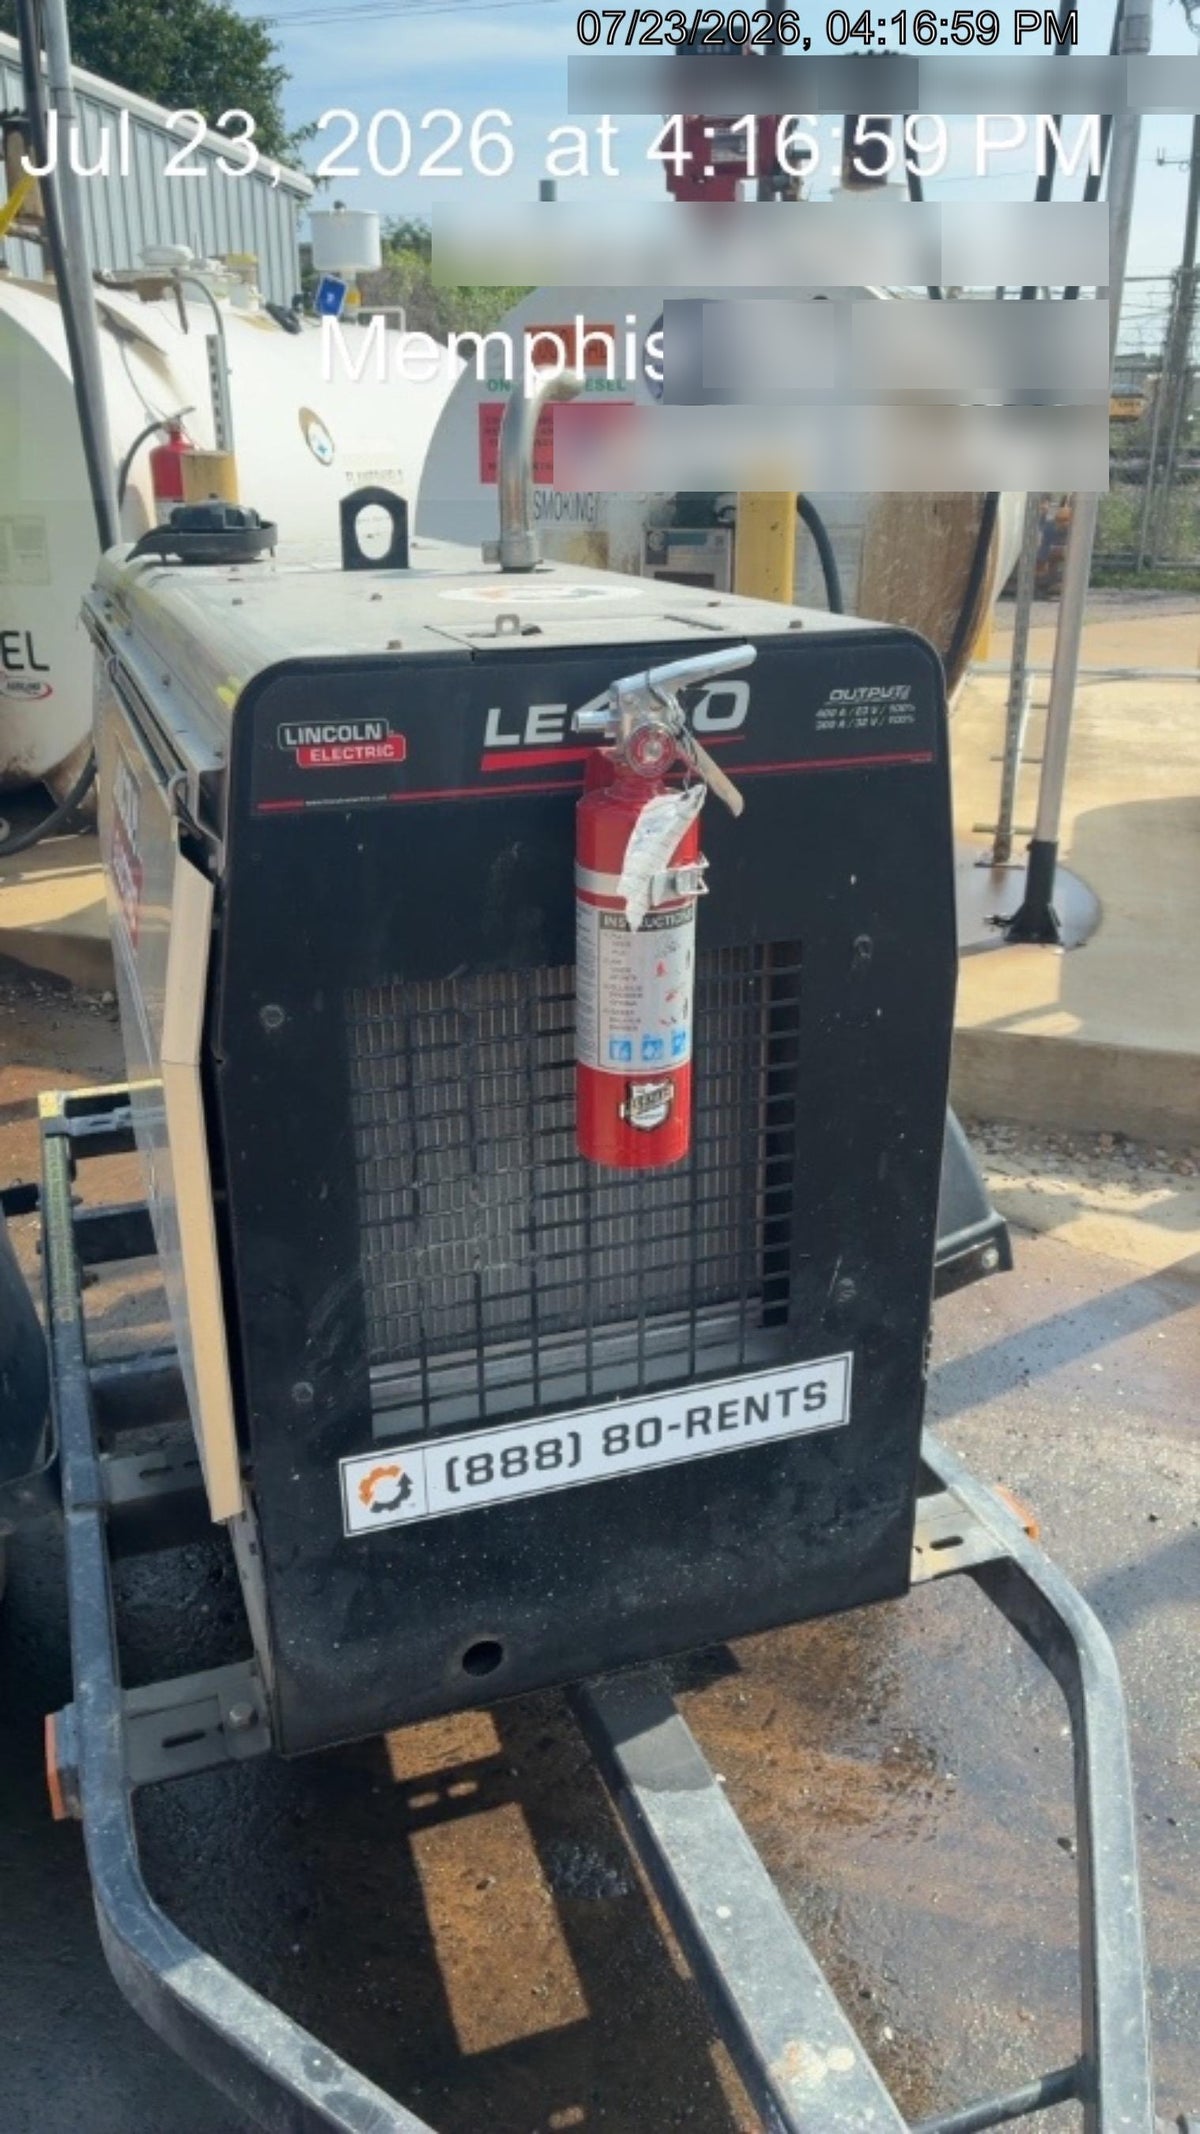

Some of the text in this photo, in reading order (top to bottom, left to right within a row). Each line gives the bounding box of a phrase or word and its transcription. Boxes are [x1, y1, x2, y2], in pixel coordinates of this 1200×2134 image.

[829, 685, 911, 701] OUTPUT
[284, 722, 382, 746] LINCOLN
[309, 743, 395, 762] ELECTRIC
[445, 1380, 828, 1493] (888) 80-RENTS
